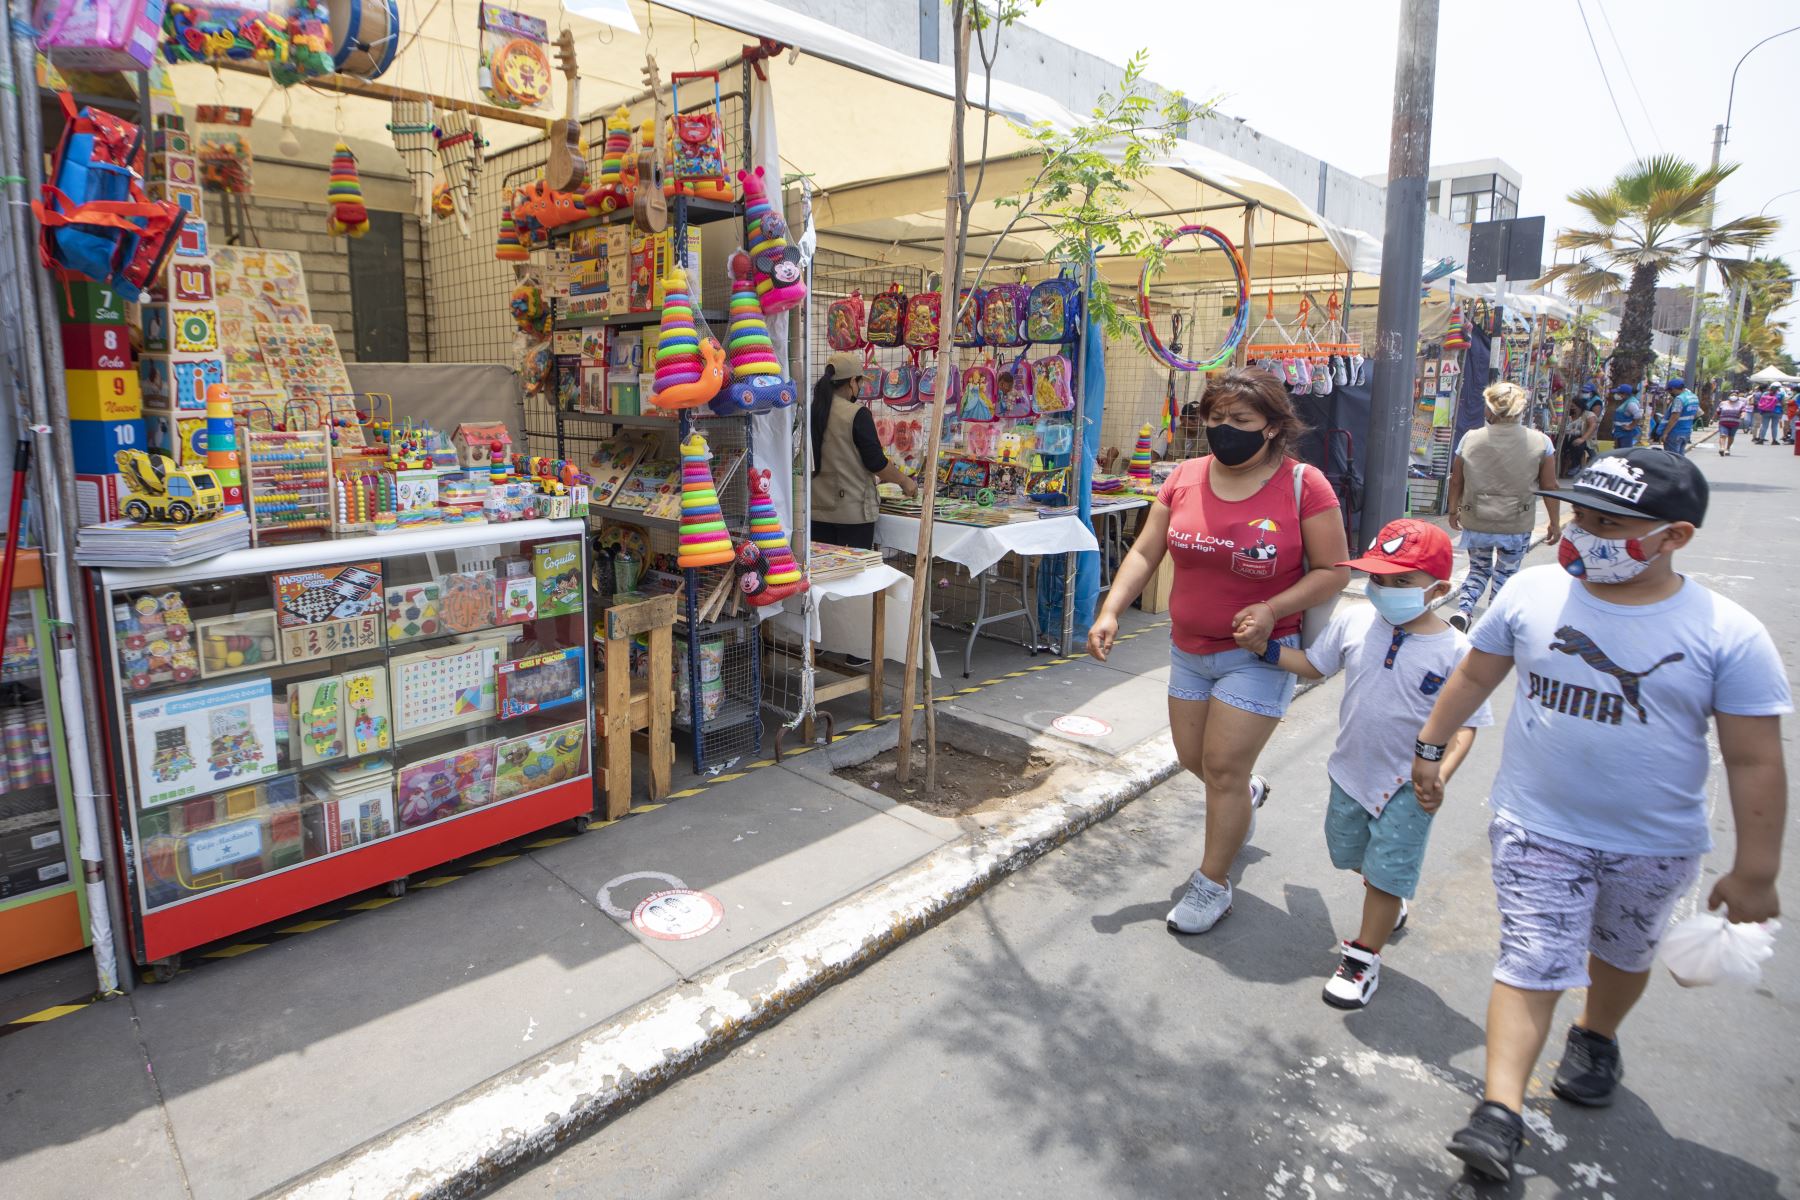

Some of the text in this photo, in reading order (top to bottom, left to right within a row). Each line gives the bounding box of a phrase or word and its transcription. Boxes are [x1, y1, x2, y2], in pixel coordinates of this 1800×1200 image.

[181, 271, 205, 294] u
[101, 290, 112, 308] 7
[104, 330, 117, 350] 8
[113, 377, 125, 395] 9
[193, 368, 205, 402] i
[113, 424, 135, 445] 10
[1191, 544, 1216, 553] High
[1196, 532, 1235, 548] Love
[544, 552, 576, 570] Coquito
[279, 572, 325, 586] Magnetic
[308, 630, 318, 642] 2
[326, 626, 335, 638] 3
[344, 623, 352, 633] 4
[363, 620, 372, 632] 5
[1528, 672, 1625, 726] PUMA
